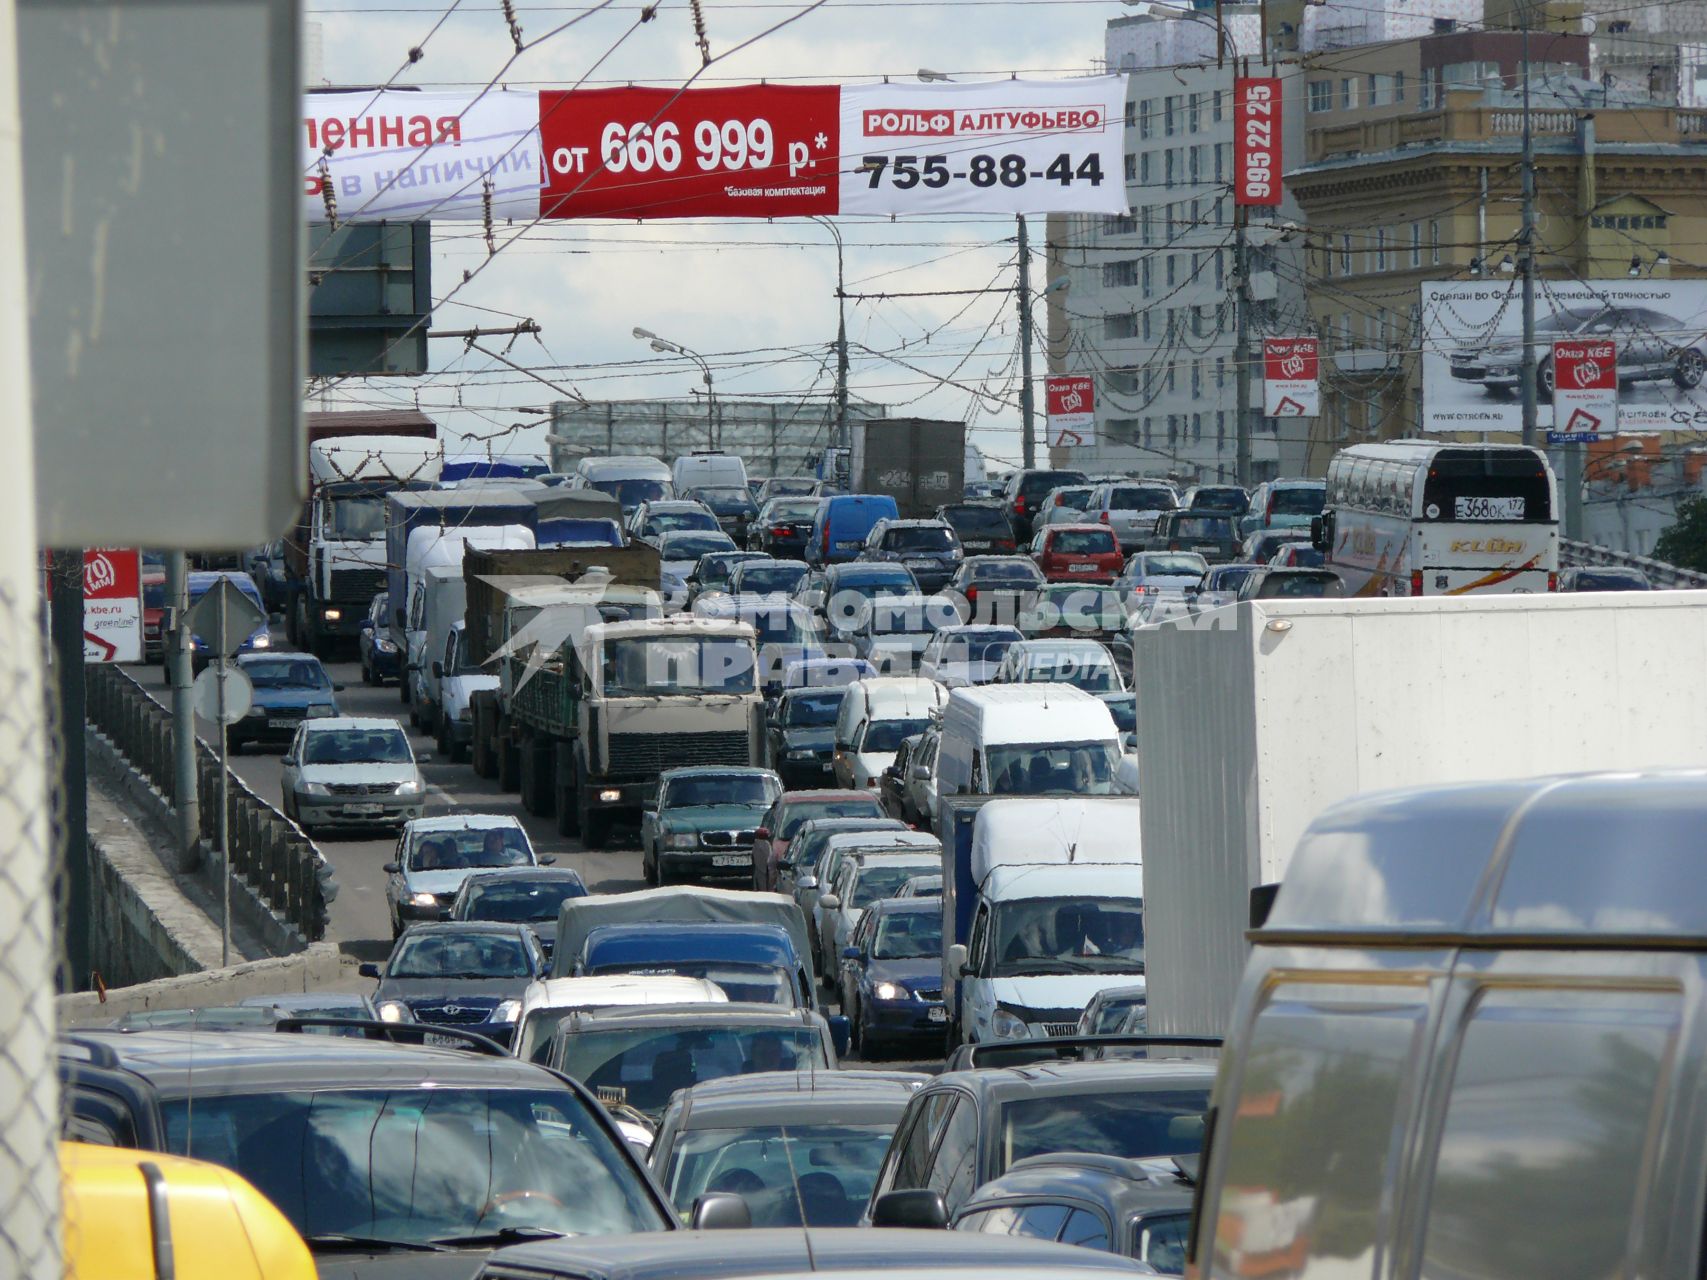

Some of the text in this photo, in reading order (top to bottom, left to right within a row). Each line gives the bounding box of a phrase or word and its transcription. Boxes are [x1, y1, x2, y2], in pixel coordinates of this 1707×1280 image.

[867, 109, 1100, 134] РОЛЬФ АЛТУФЬЕВО
[552, 147, 588, 174] от
[600, 120, 682, 173] 666
[693, 118, 774, 171] 999
[1245, 84, 1272, 199] 995 22 25
[341, 175, 362, 197] в
[374, 150, 532, 193] наличии
[862, 153, 1105, 189] 755-88-44
[764, 185, 826, 197] комплектация
[1430, 291, 1472, 302] Сделан
[1474, 291, 1489, 300] во
[1611, 291, 1671, 300] точностью
